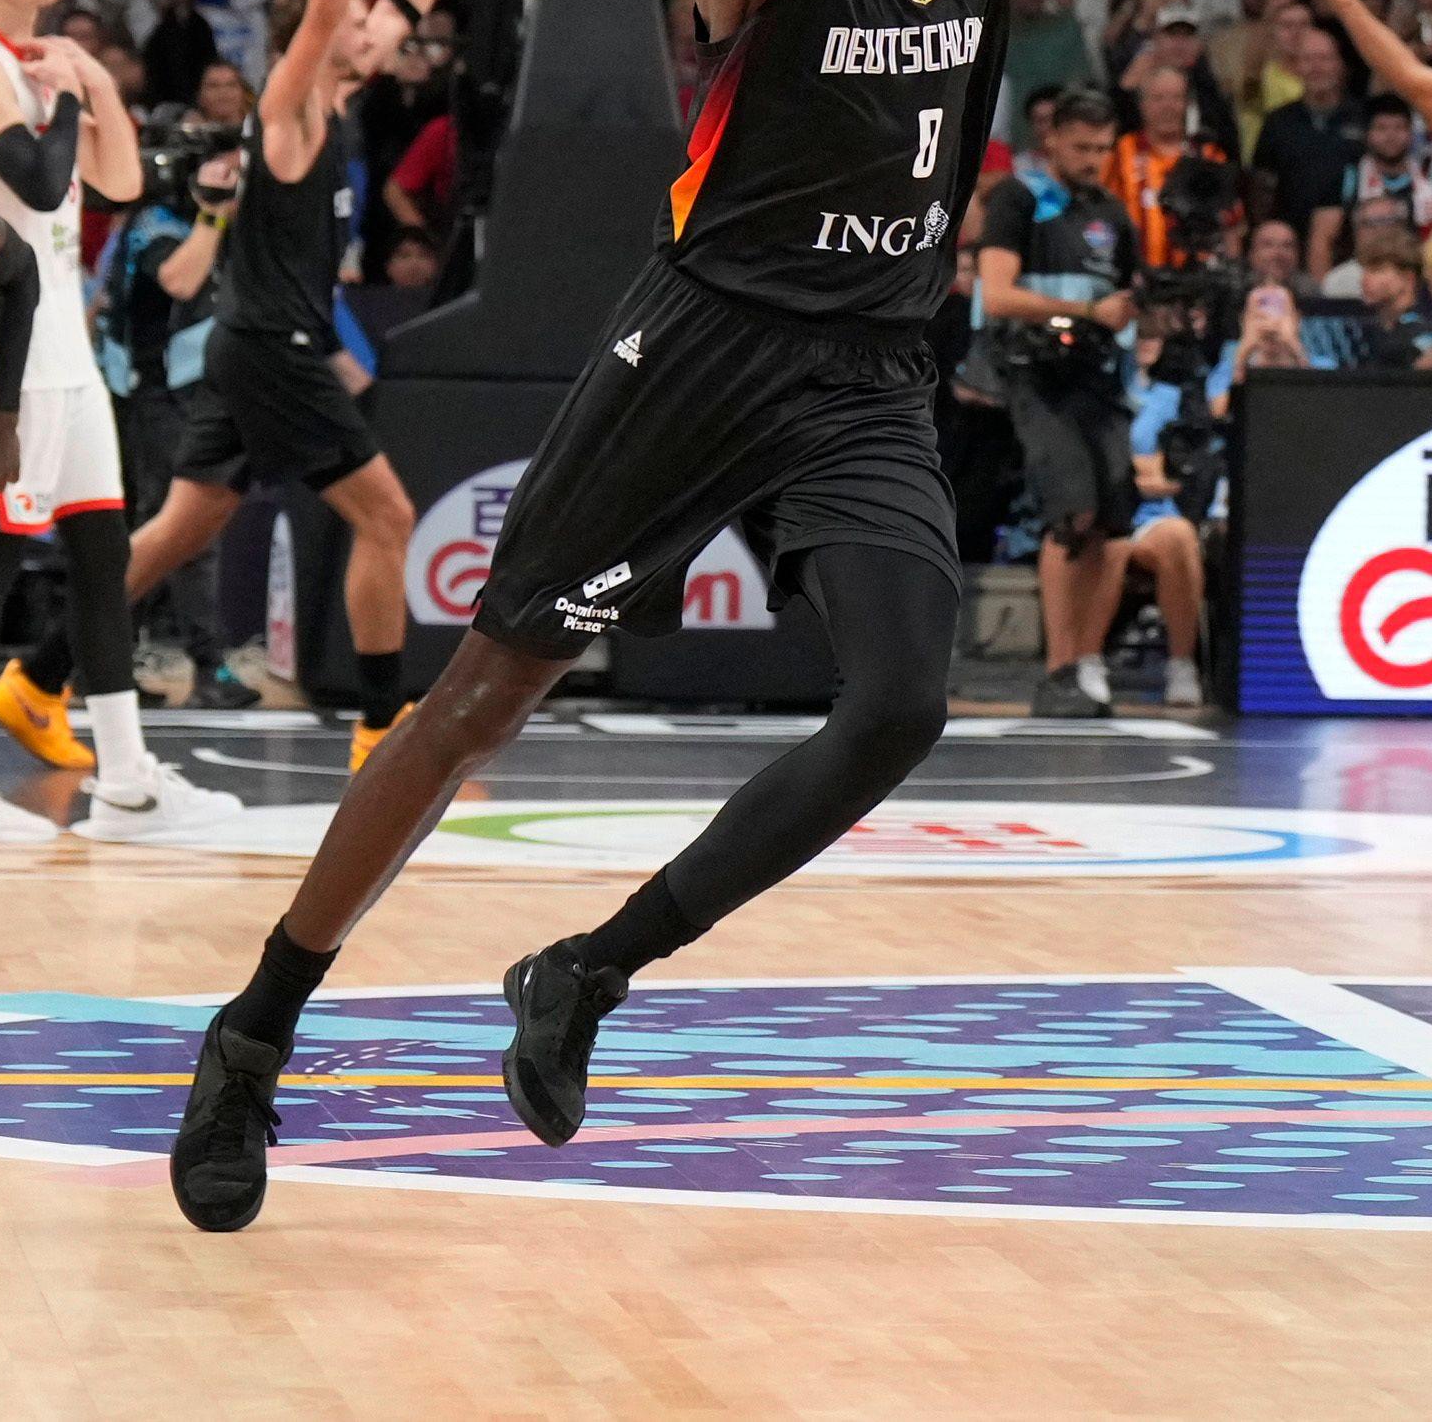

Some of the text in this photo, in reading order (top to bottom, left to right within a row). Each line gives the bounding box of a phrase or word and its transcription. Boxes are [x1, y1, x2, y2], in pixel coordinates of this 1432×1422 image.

[819, 16, 985, 75] DEUTSCHLAN
[912, 107, 944, 179] 0
[812, 211, 917, 257] ING
[554, 597, 620, 621] Domino's
[562, 615, 606, 634] Pizza
